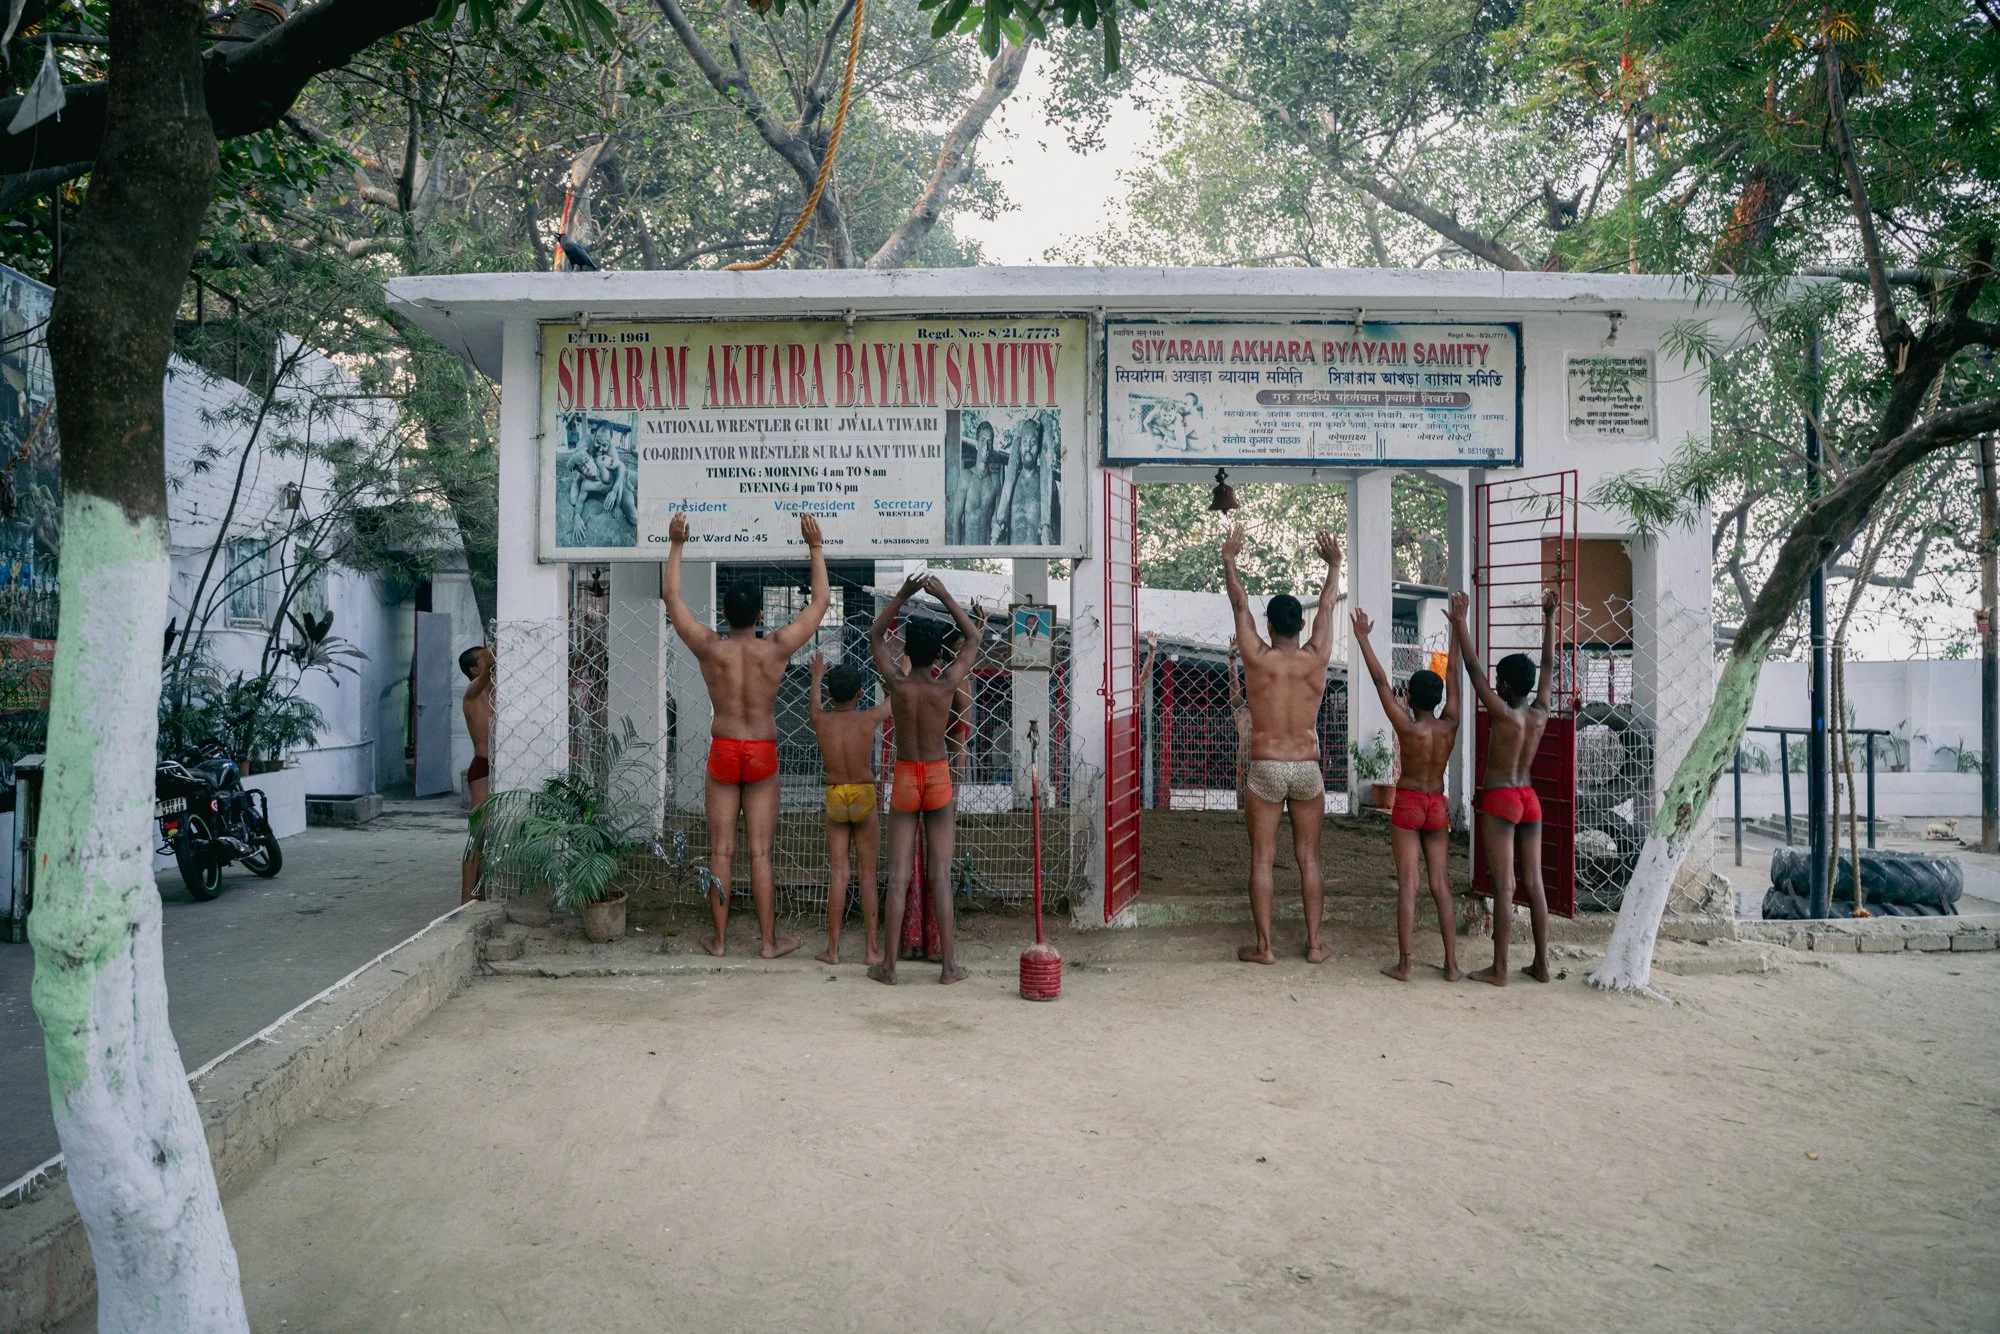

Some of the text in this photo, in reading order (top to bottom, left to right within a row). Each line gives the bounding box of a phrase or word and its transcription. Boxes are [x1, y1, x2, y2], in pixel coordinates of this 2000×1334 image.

[568, 332, 649, 343] ETD.: 1961
[917, 327, 1060, 341] Regd. No:- S/2L/7773
[1131, 339, 1491, 366] SIYARAM AKHARA BYAYAM SAMITY
[557, 342, 1063, 411] SIYARAM AKHARA BAYAM SAMITY
[1115, 365, 1303, 385] सियाराम अखाड़ा व्यायाम समिति
[1467, 369, 1503, 387] সমিতি
[1295, 391, 1330, 404] राष्ट्रीय
[1335, 392, 1379, 404] पहलवान
[1421, 393, 1455, 404] तिवारी
[646, 417, 938, 434] NATIONAL WRESTLER GURU JWALA TIWARI
[1222, 433, 1301, 447] संतोष कुमार पाठक
[643, 443, 942, 462] CO-ORDINATOR WRESTLER SURAJ KANT TIWARI
[705, 466, 757, 479] TIMEING
[764, 466, 819, 478] MORNING
[821, 466, 828, 477] 4
[830, 468, 845, 477] am
[846, 465, 862, 477] TO
[864, 465, 871, 477] 8
[872, 468, 887, 477] am
[739, 482, 858, 496] EVENING 4 pm TO 8 pm
[668, 502, 728, 512] President
[774, 500, 856, 511] Vice-President
[873, 499, 933, 512] Secretary
[703, 533, 728, 543] Ward
[734, 534, 749, 543] No
